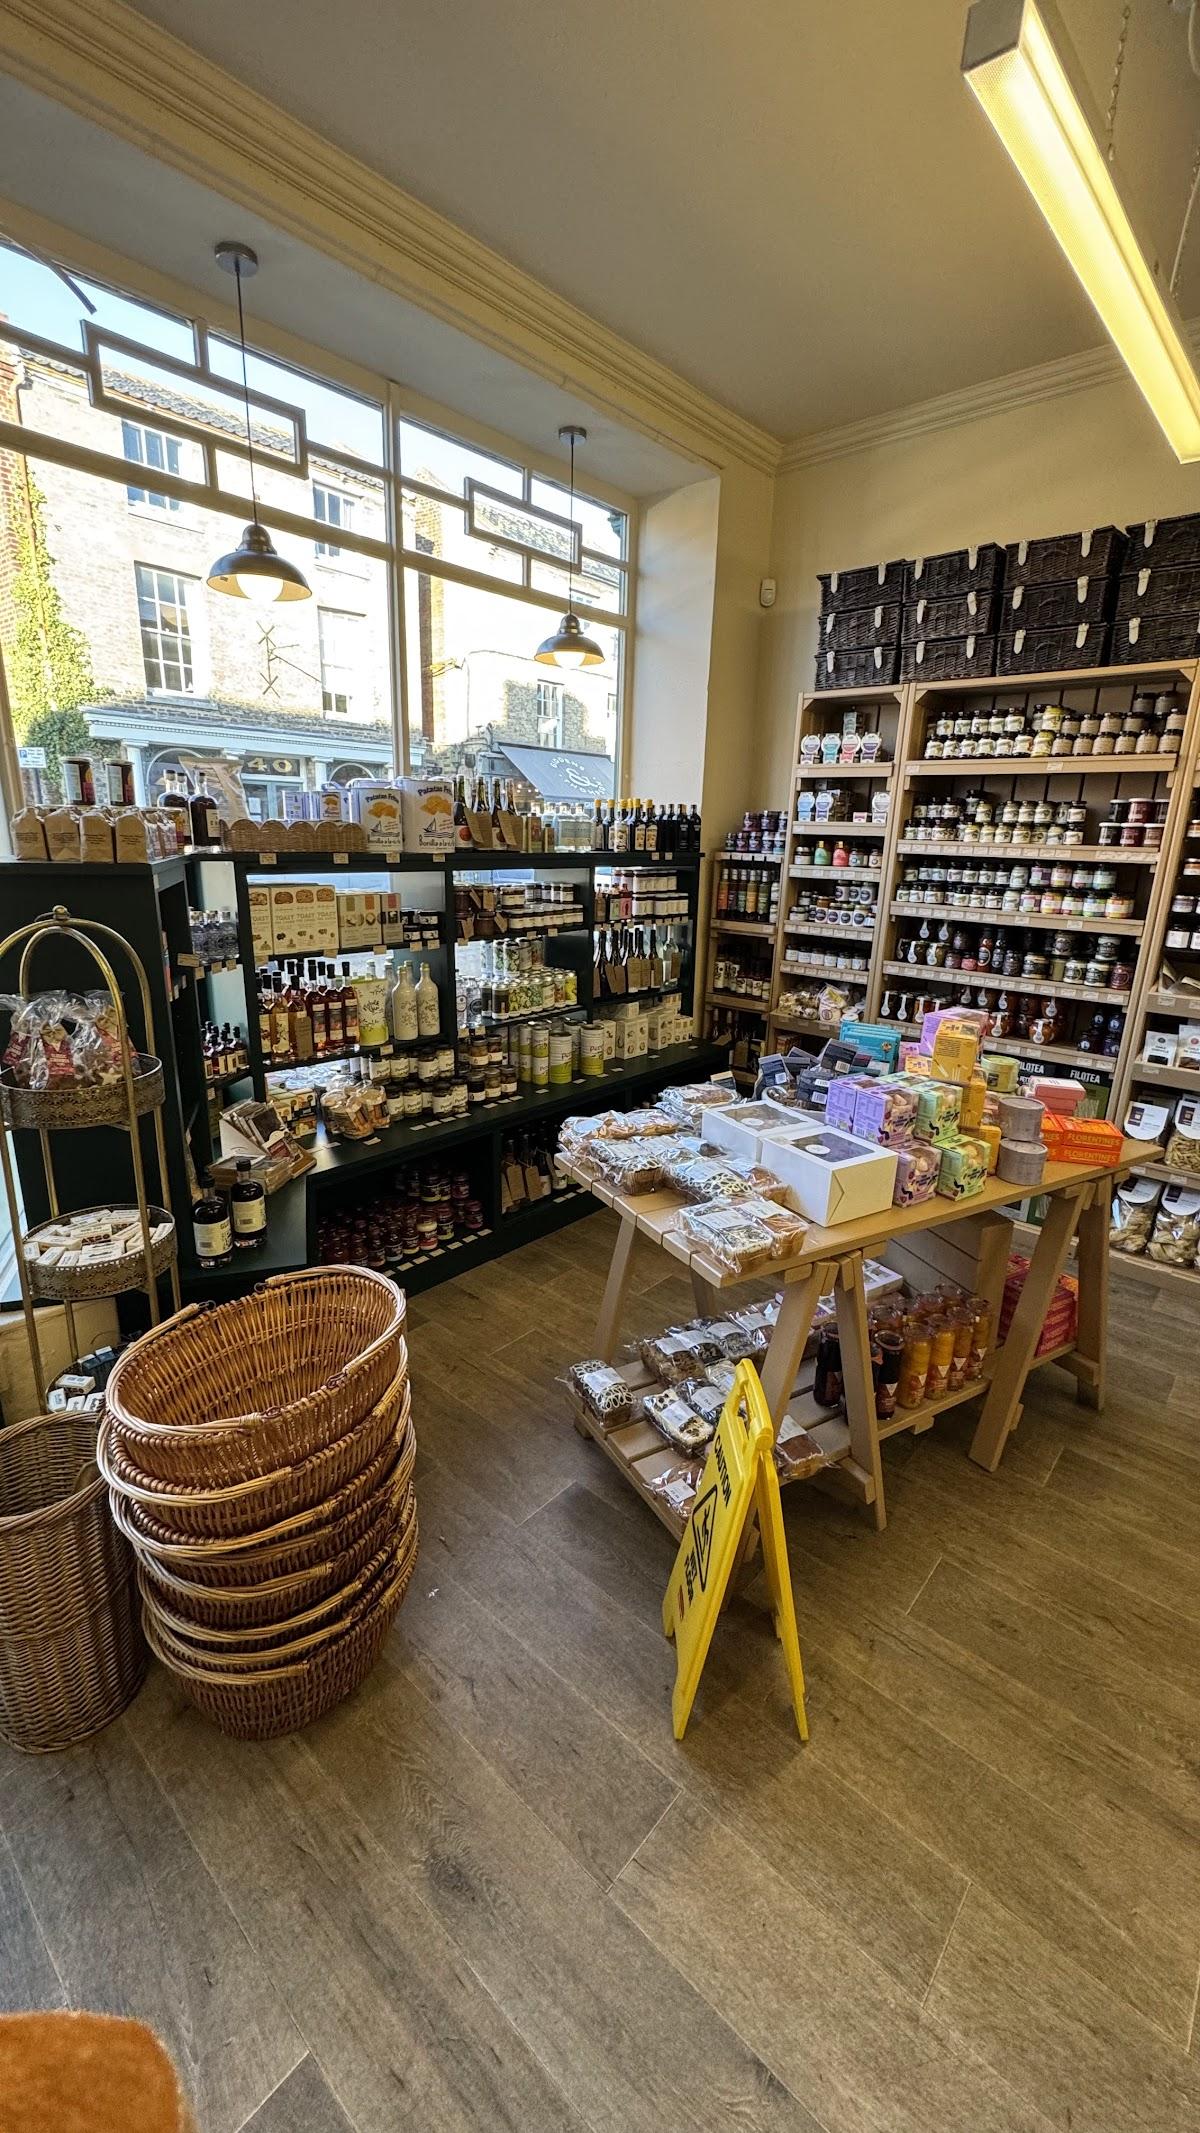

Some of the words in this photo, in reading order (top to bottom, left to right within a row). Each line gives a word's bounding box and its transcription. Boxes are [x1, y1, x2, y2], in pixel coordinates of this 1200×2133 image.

[247, 757, 293, 773] 40
[1019, 1061, 1045, 1074] ILOTEA
[1069, 1069, 1101, 1084] FILOTEA
[1067, 1132, 1120, 1146] FLORENTINES
[1063, 1150, 1117, 1162] FLORENTINES
[714, 1435, 732, 1507] CAUTION
